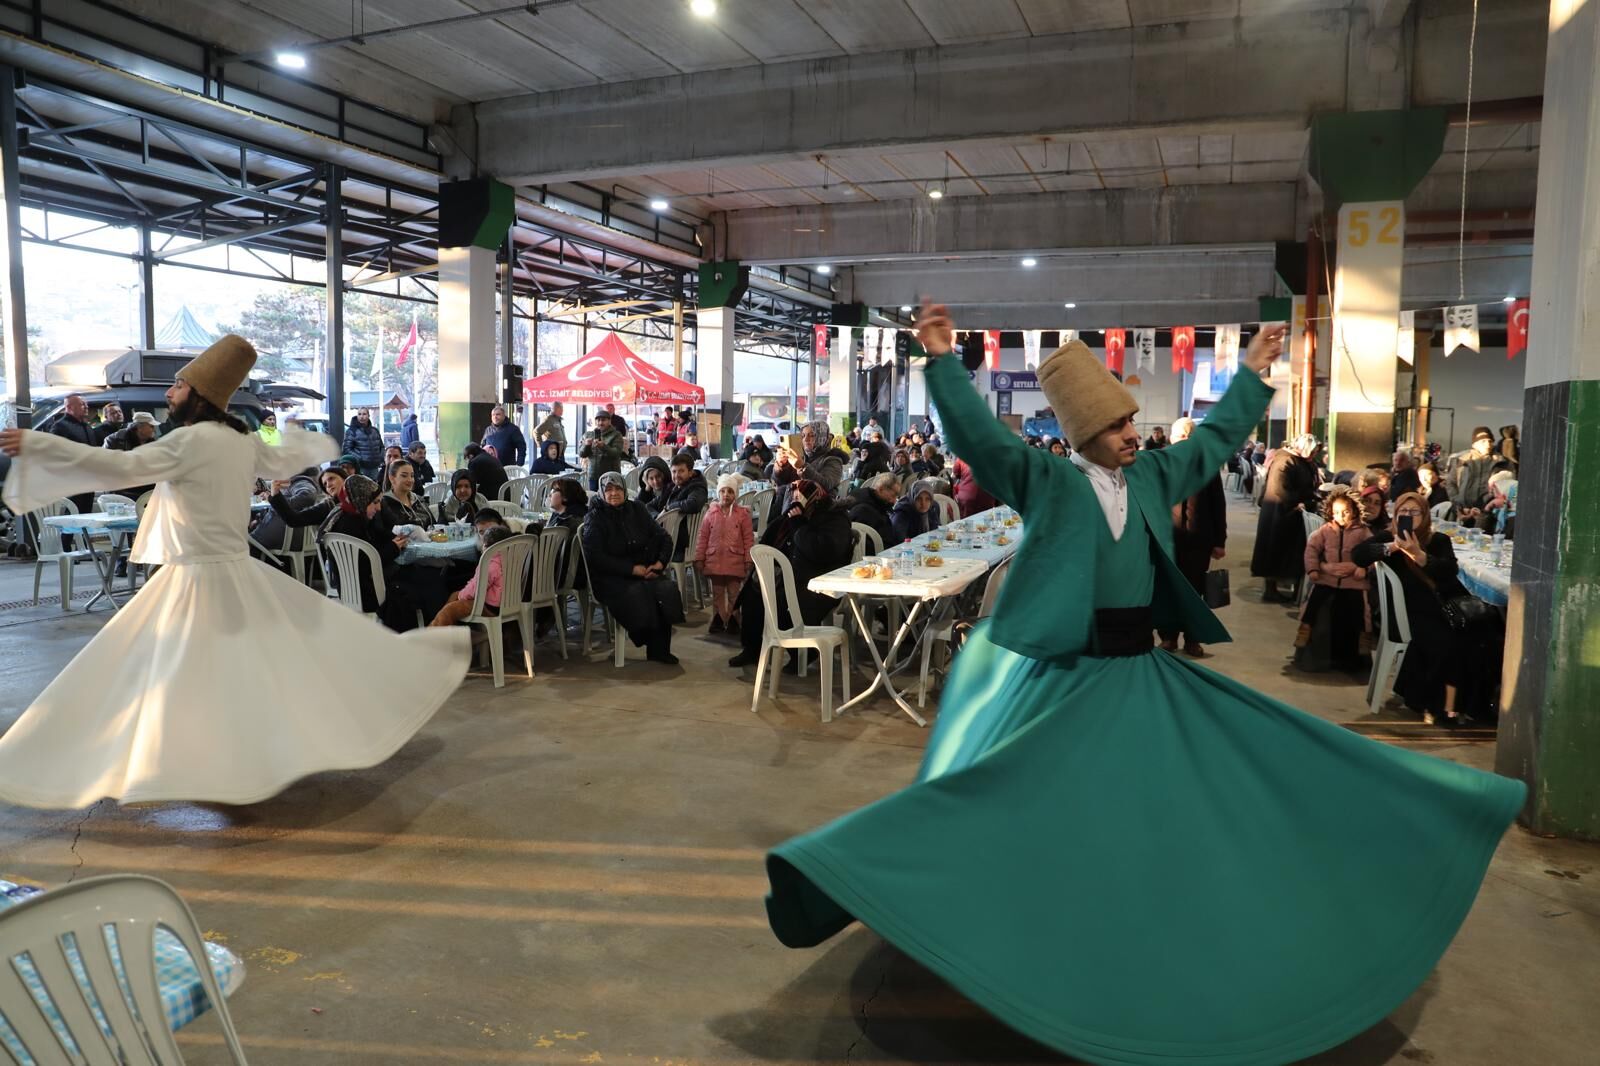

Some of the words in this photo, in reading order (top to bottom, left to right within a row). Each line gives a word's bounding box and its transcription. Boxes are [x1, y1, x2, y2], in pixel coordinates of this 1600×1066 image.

[1347, 207, 1401, 247] 52
[533, 389, 548, 398] T.C.
[549, 387, 569, 398] İZMİT
[571, 387, 613, 398] BELEDİYESİ
